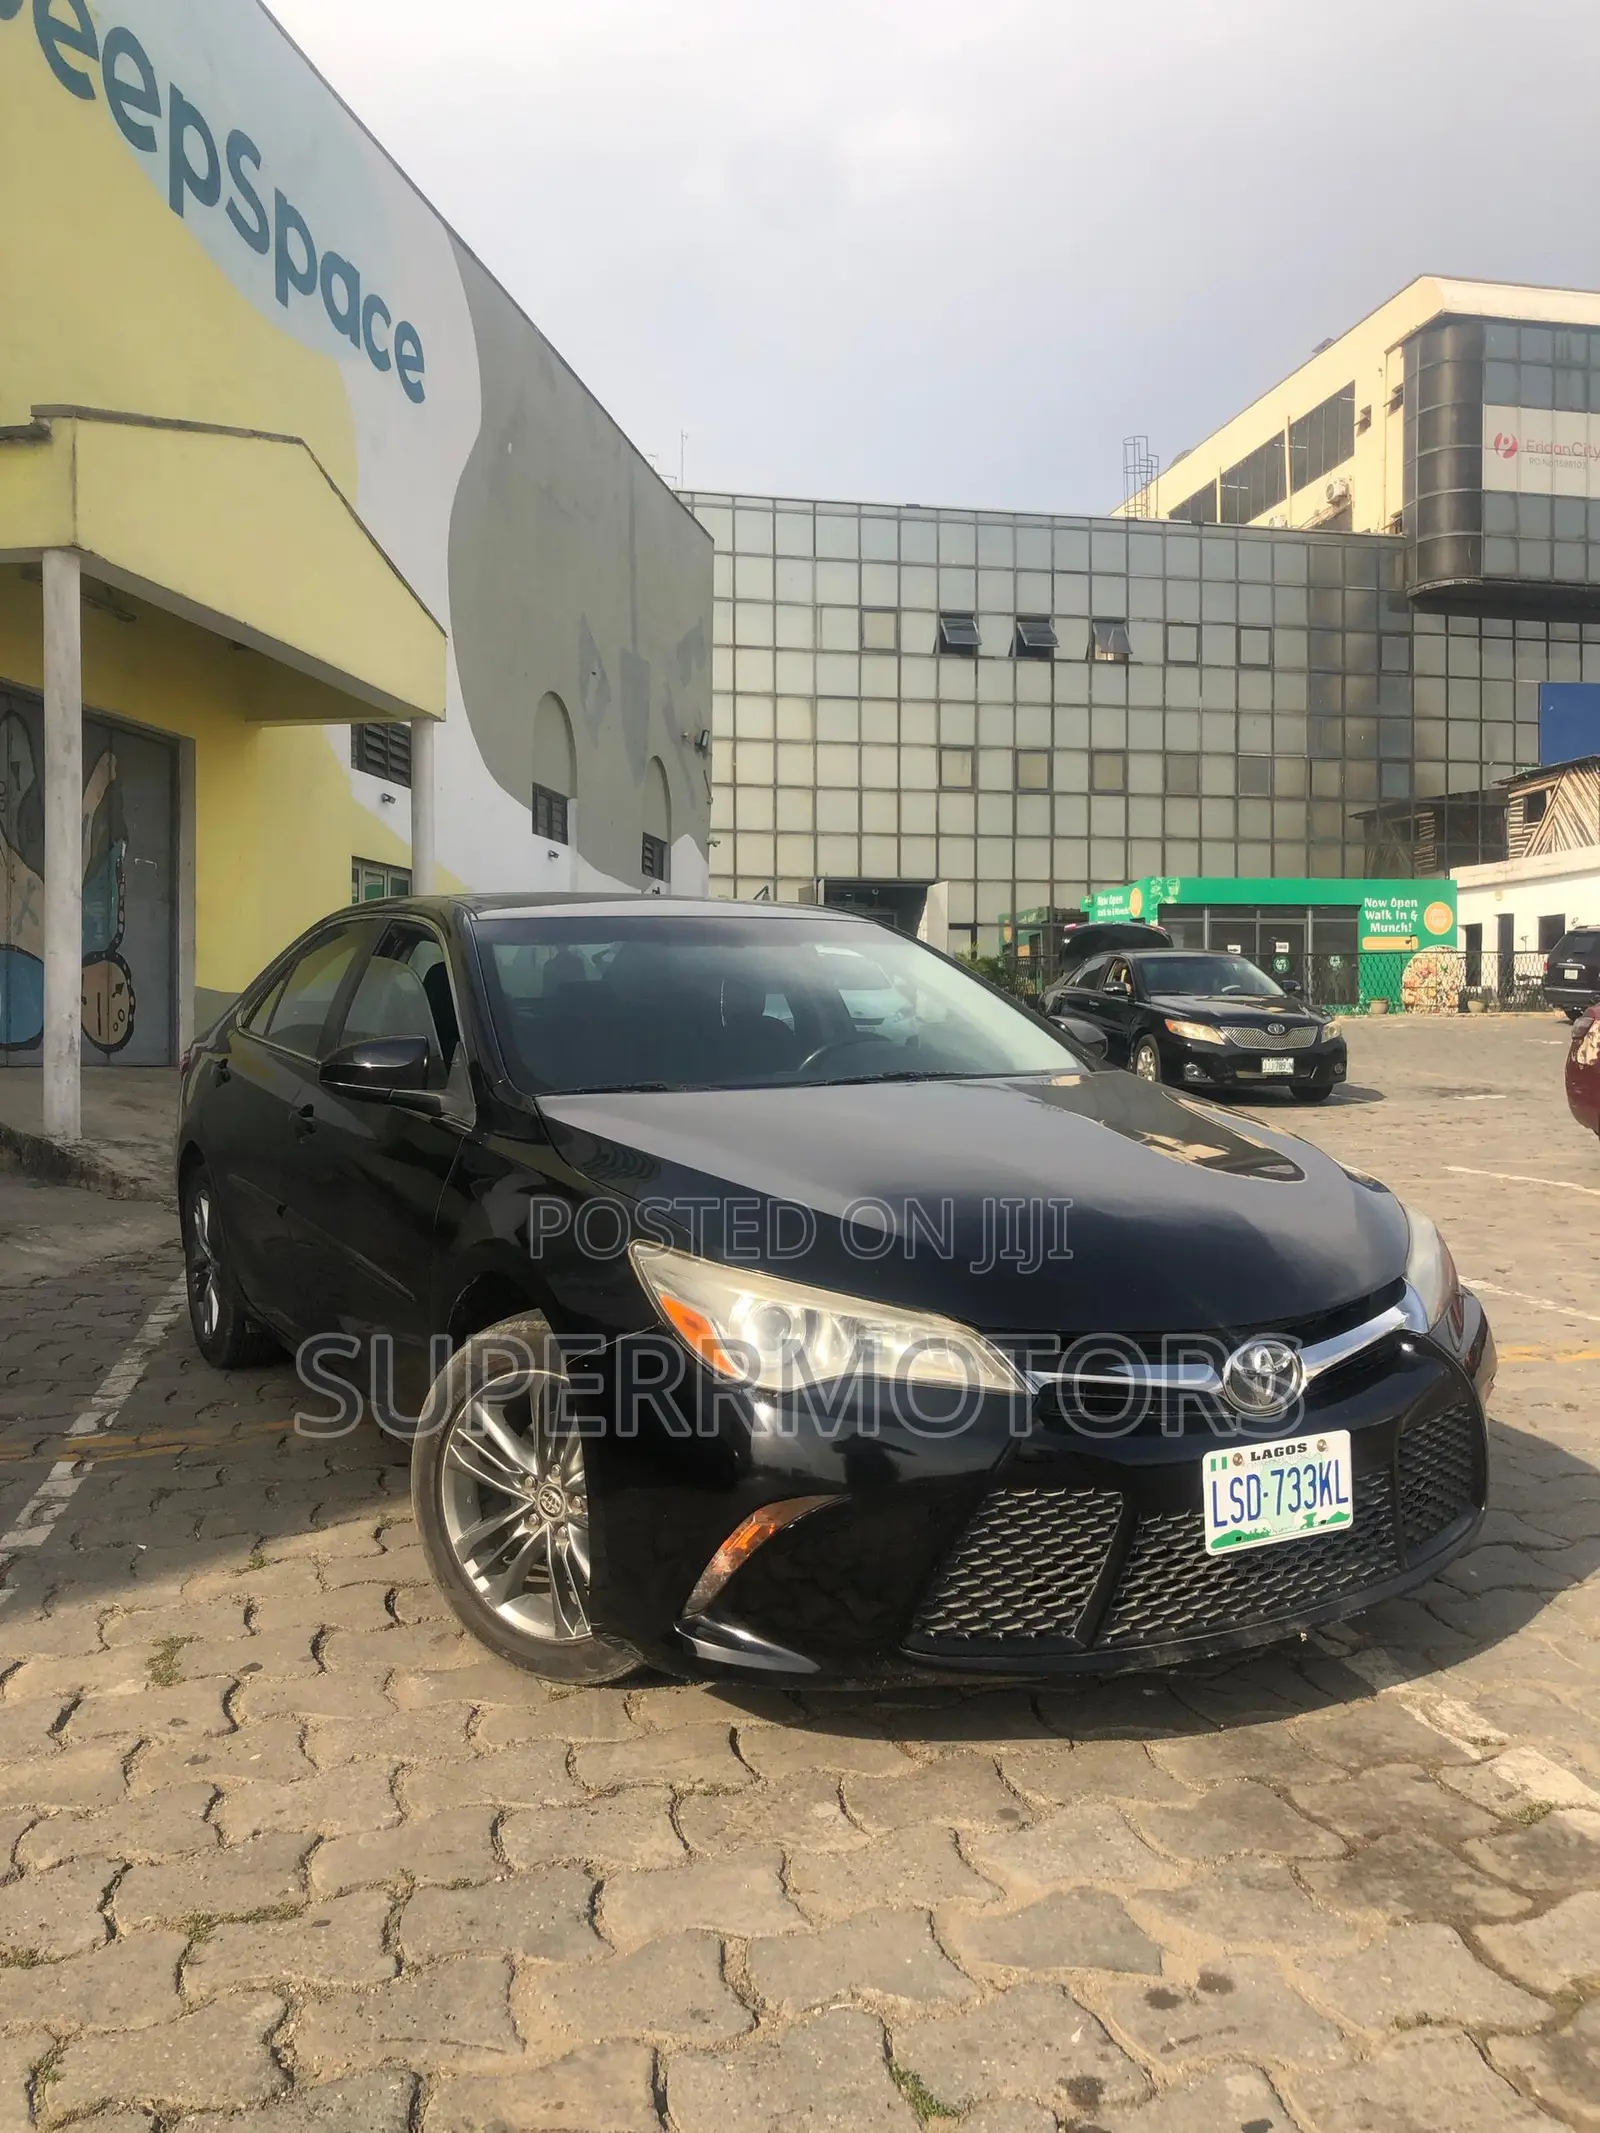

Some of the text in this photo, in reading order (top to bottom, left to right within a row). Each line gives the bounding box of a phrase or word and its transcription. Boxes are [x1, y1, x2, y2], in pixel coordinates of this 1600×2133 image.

[0, 0, 426, 404] eepspace
[1364, 897, 1418, 909] Now Open
[1365, 910, 1392, 920] Walk
[1396, 910, 1407, 920] In
[1411, 910, 1418, 922] &
[1370, 922, 1412, 932] Munch!
[1250, 1443, 1308, 1461] LAGOS
[1212, 1459, 1349, 1528] LSD-733KL
